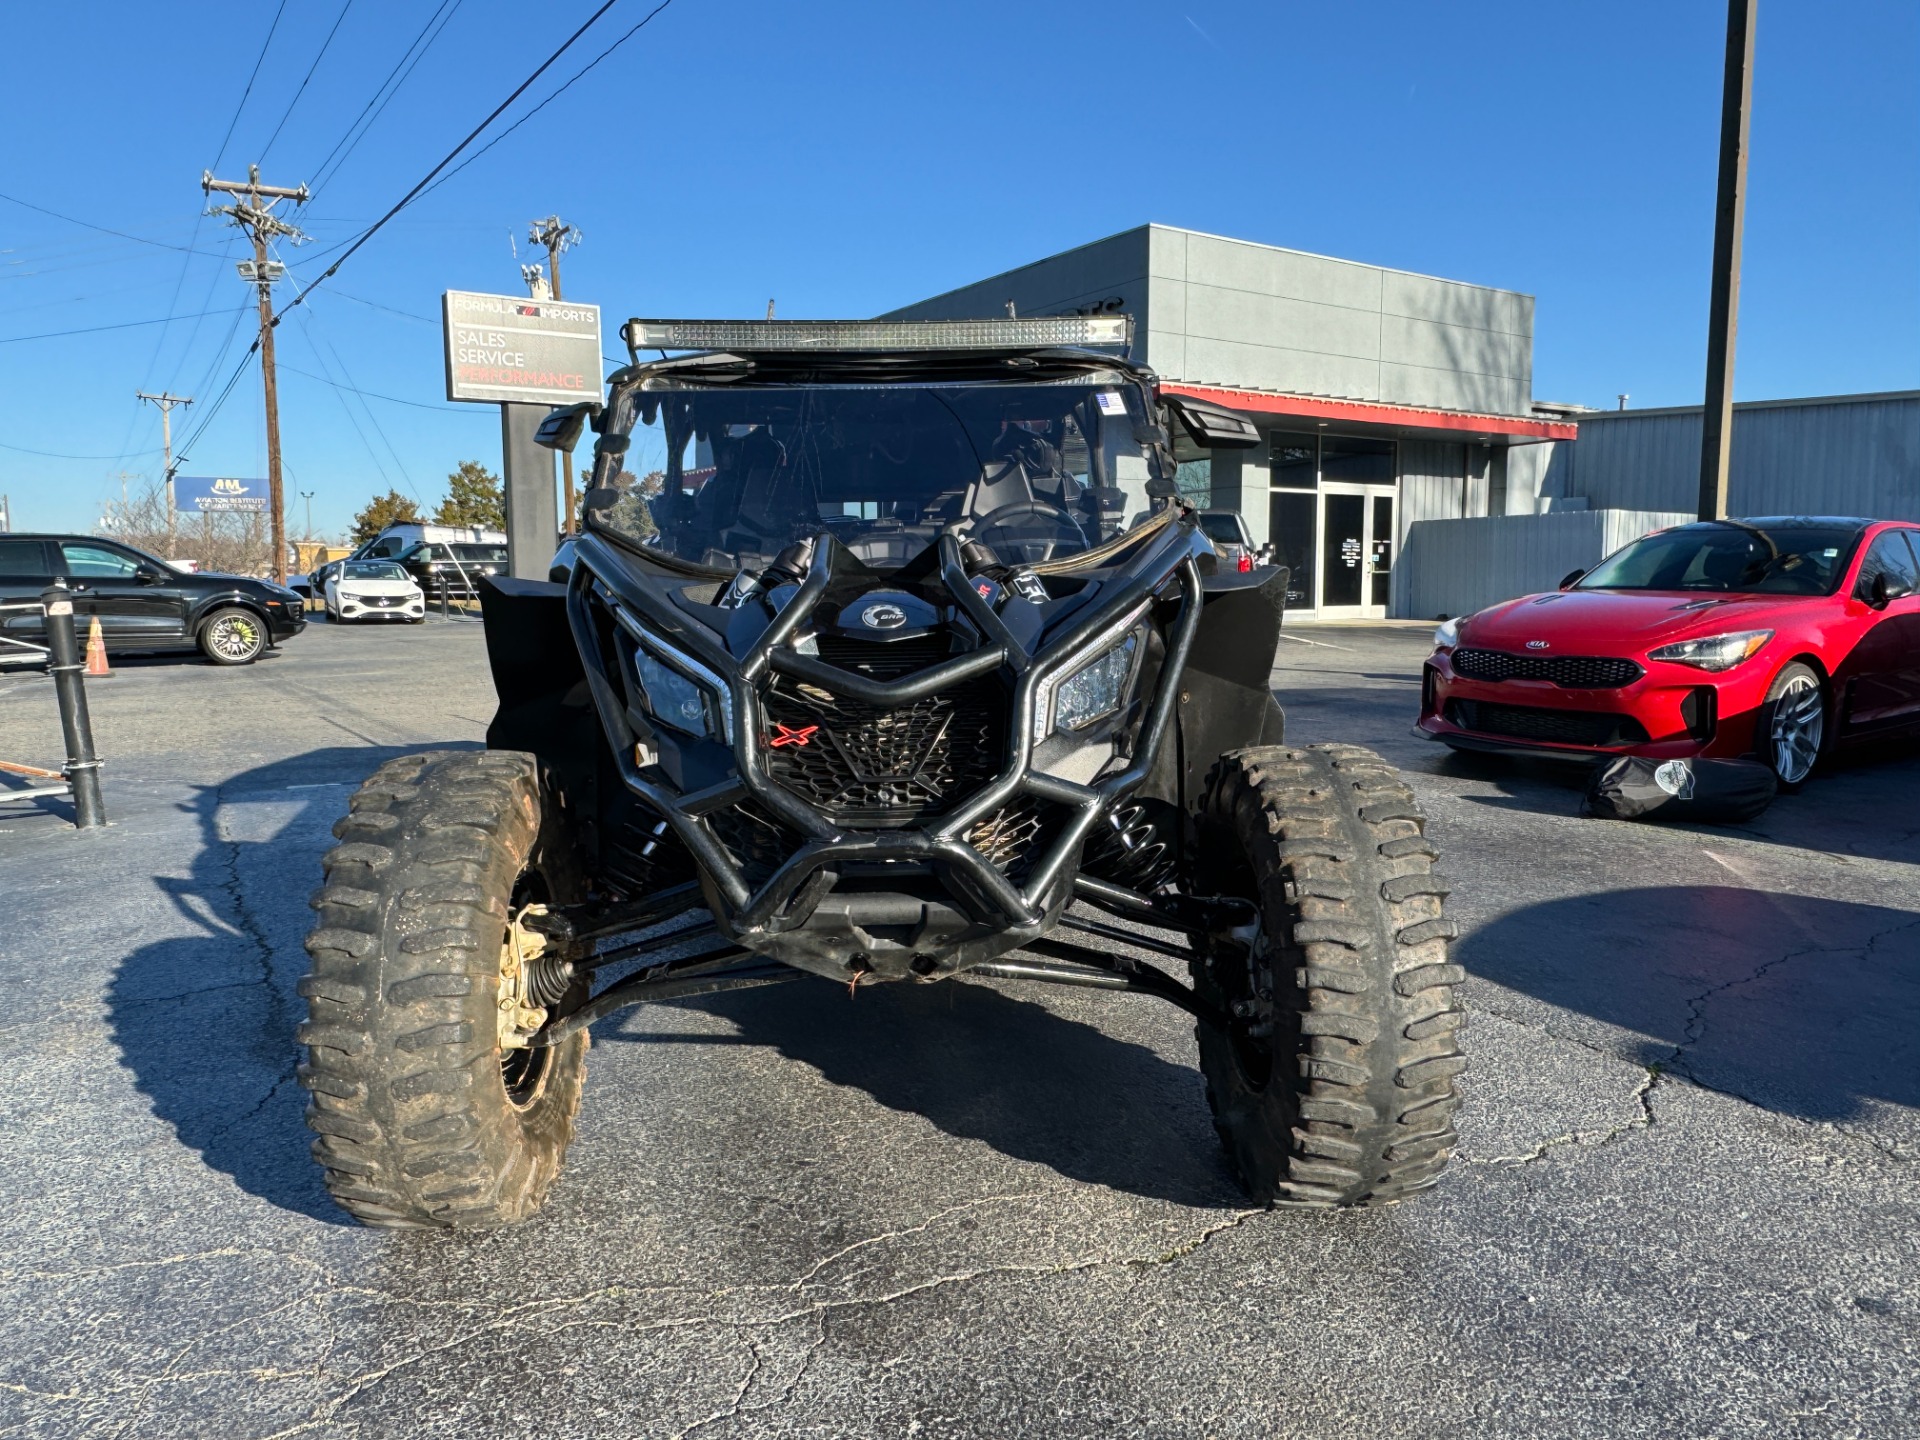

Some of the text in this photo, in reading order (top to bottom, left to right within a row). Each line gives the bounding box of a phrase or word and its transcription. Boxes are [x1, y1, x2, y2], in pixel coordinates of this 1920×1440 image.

[454, 300, 595, 323] FORMULA IMPORTS
[457, 330, 506, 348] SALES
[458, 349, 525, 367] SERVICE
[459, 366, 584, 388] PERFORMANCE
